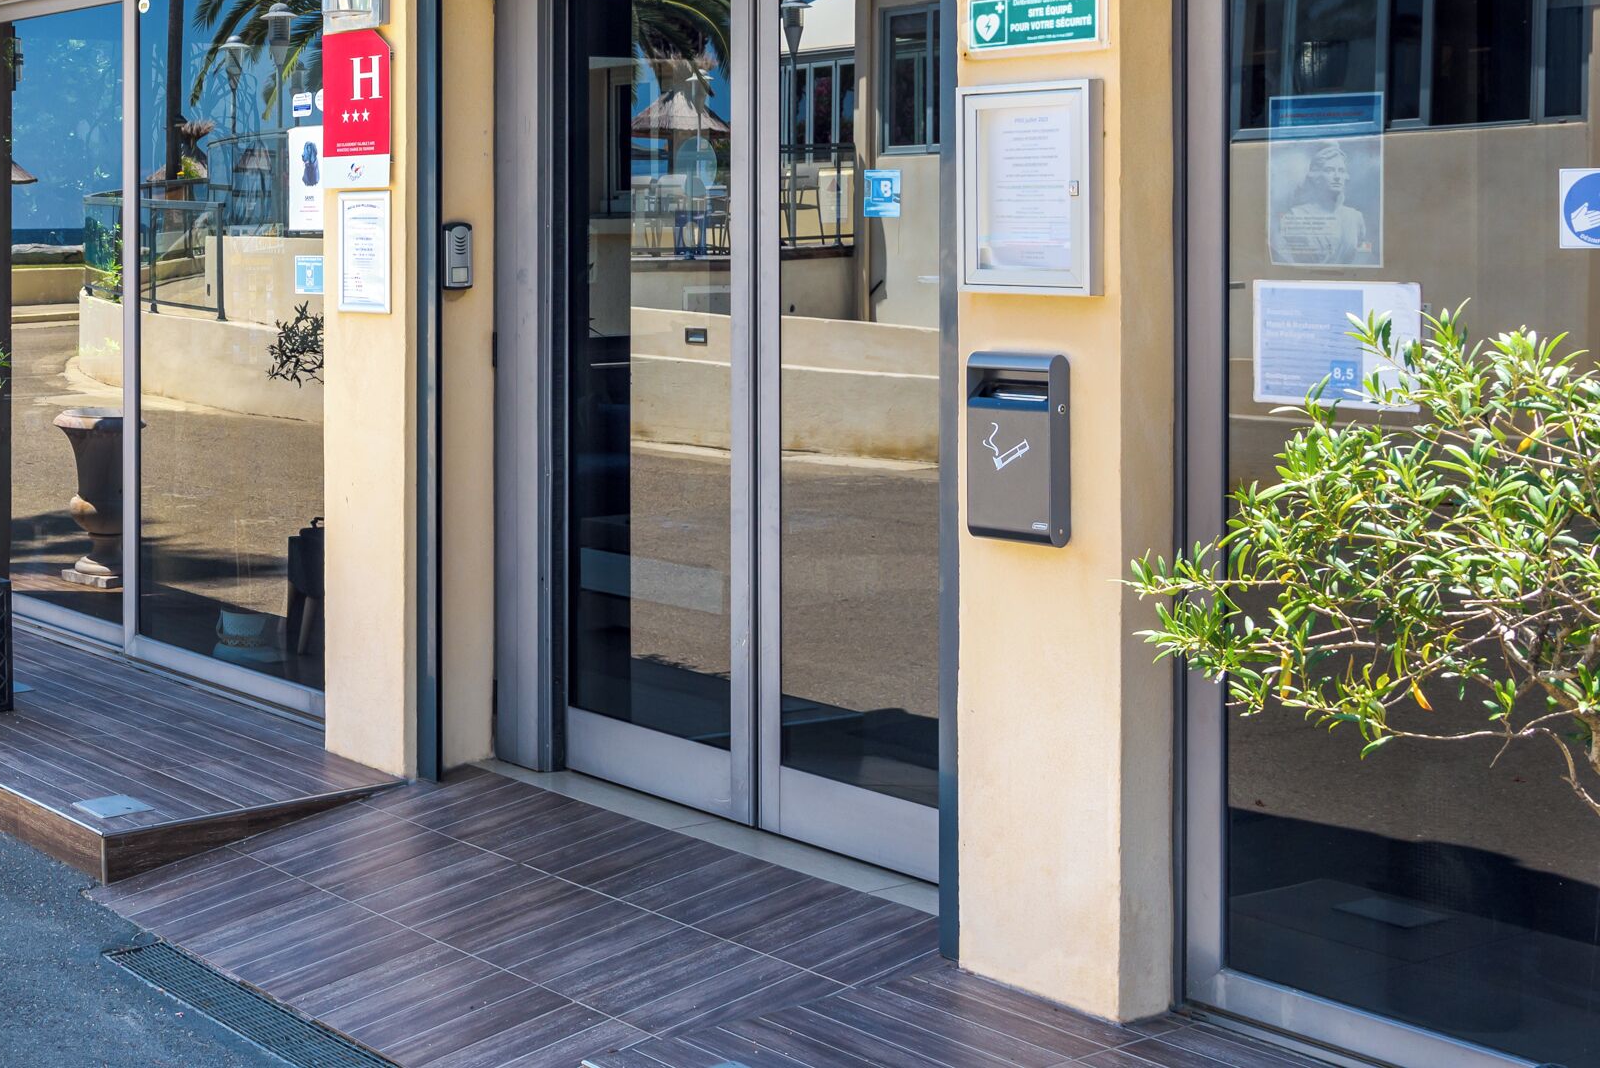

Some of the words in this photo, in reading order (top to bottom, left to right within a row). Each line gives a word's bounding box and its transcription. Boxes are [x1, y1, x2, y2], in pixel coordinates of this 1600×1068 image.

[1028, 7, 1044, 18] SITE
[1045, 2, 1073, 16] ÉQUIPÉ
[1010, 22, 1030, 32] POUR
[1030, 19, 1054, 30] VOTRE
[1055, 13, 1092, 28] SÉCURITÉ
[350, 54, 382, 100] H
[1333, 367, 1354, 381] 8,5
